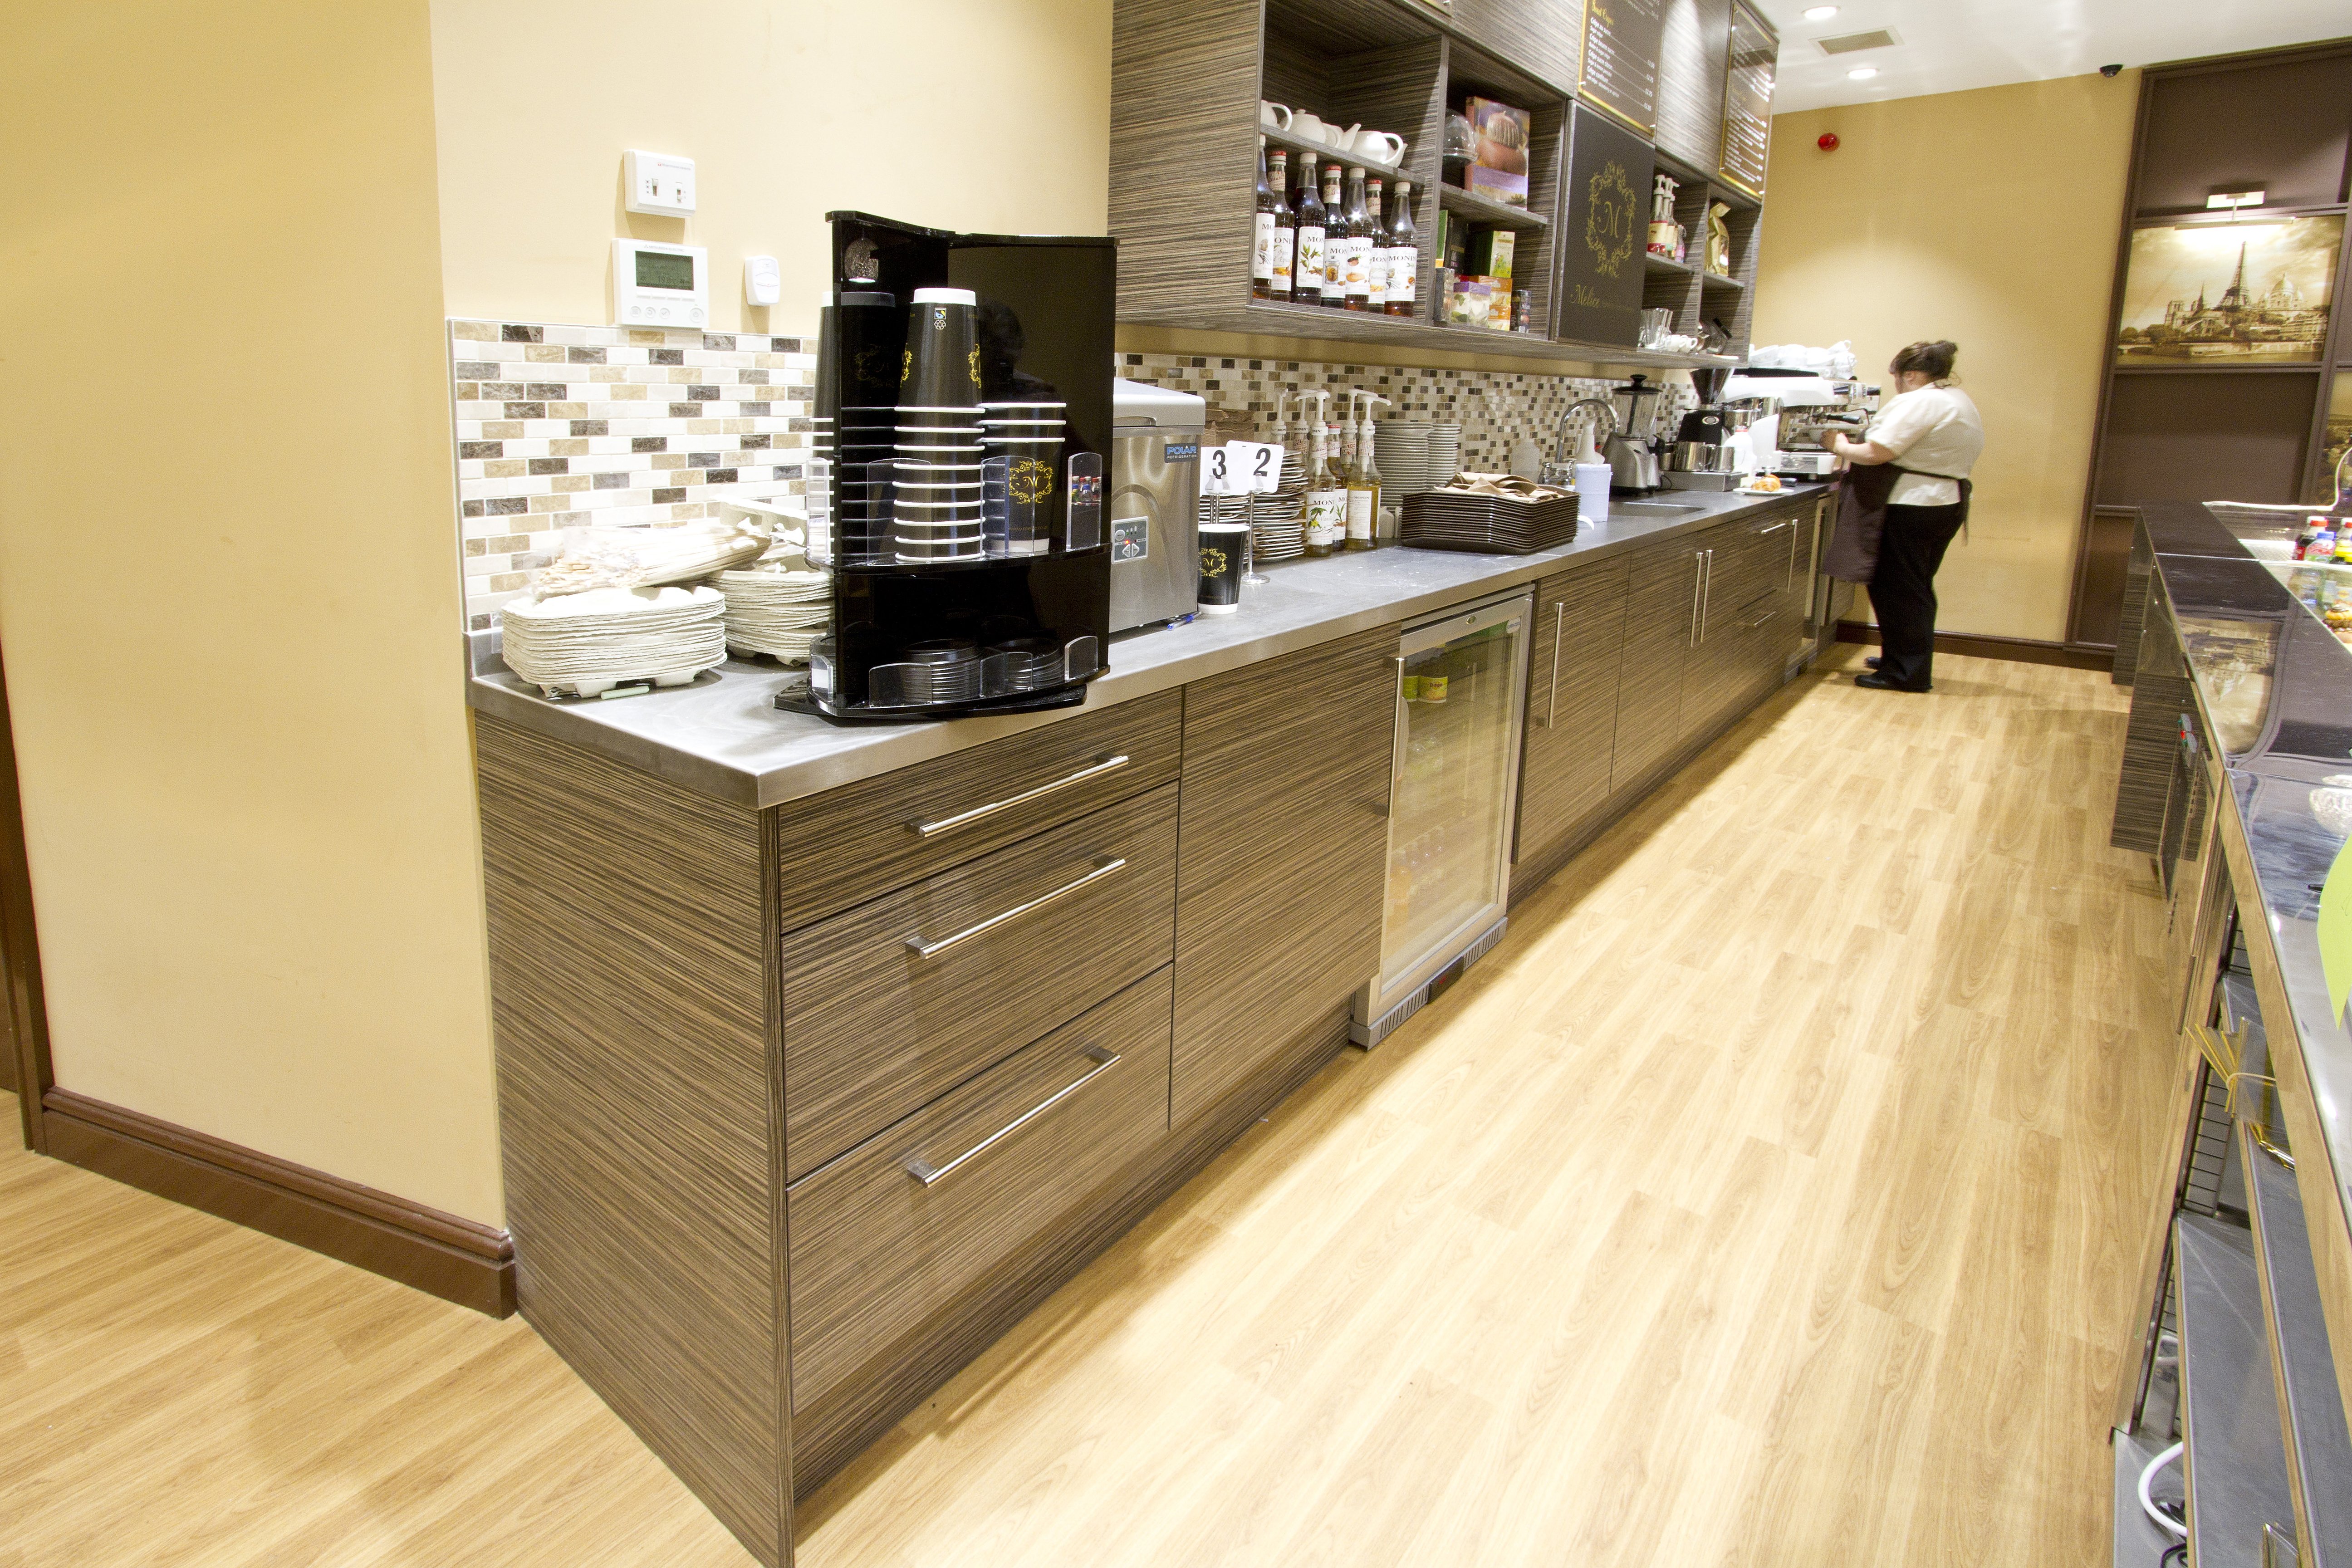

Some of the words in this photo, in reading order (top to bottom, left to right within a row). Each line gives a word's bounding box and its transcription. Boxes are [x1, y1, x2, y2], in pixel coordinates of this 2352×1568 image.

[1167, 446, 1197, 455] POLAR
[1212, 450, 1227, 480] 3
[1253, 448, 1271, 477] 2
